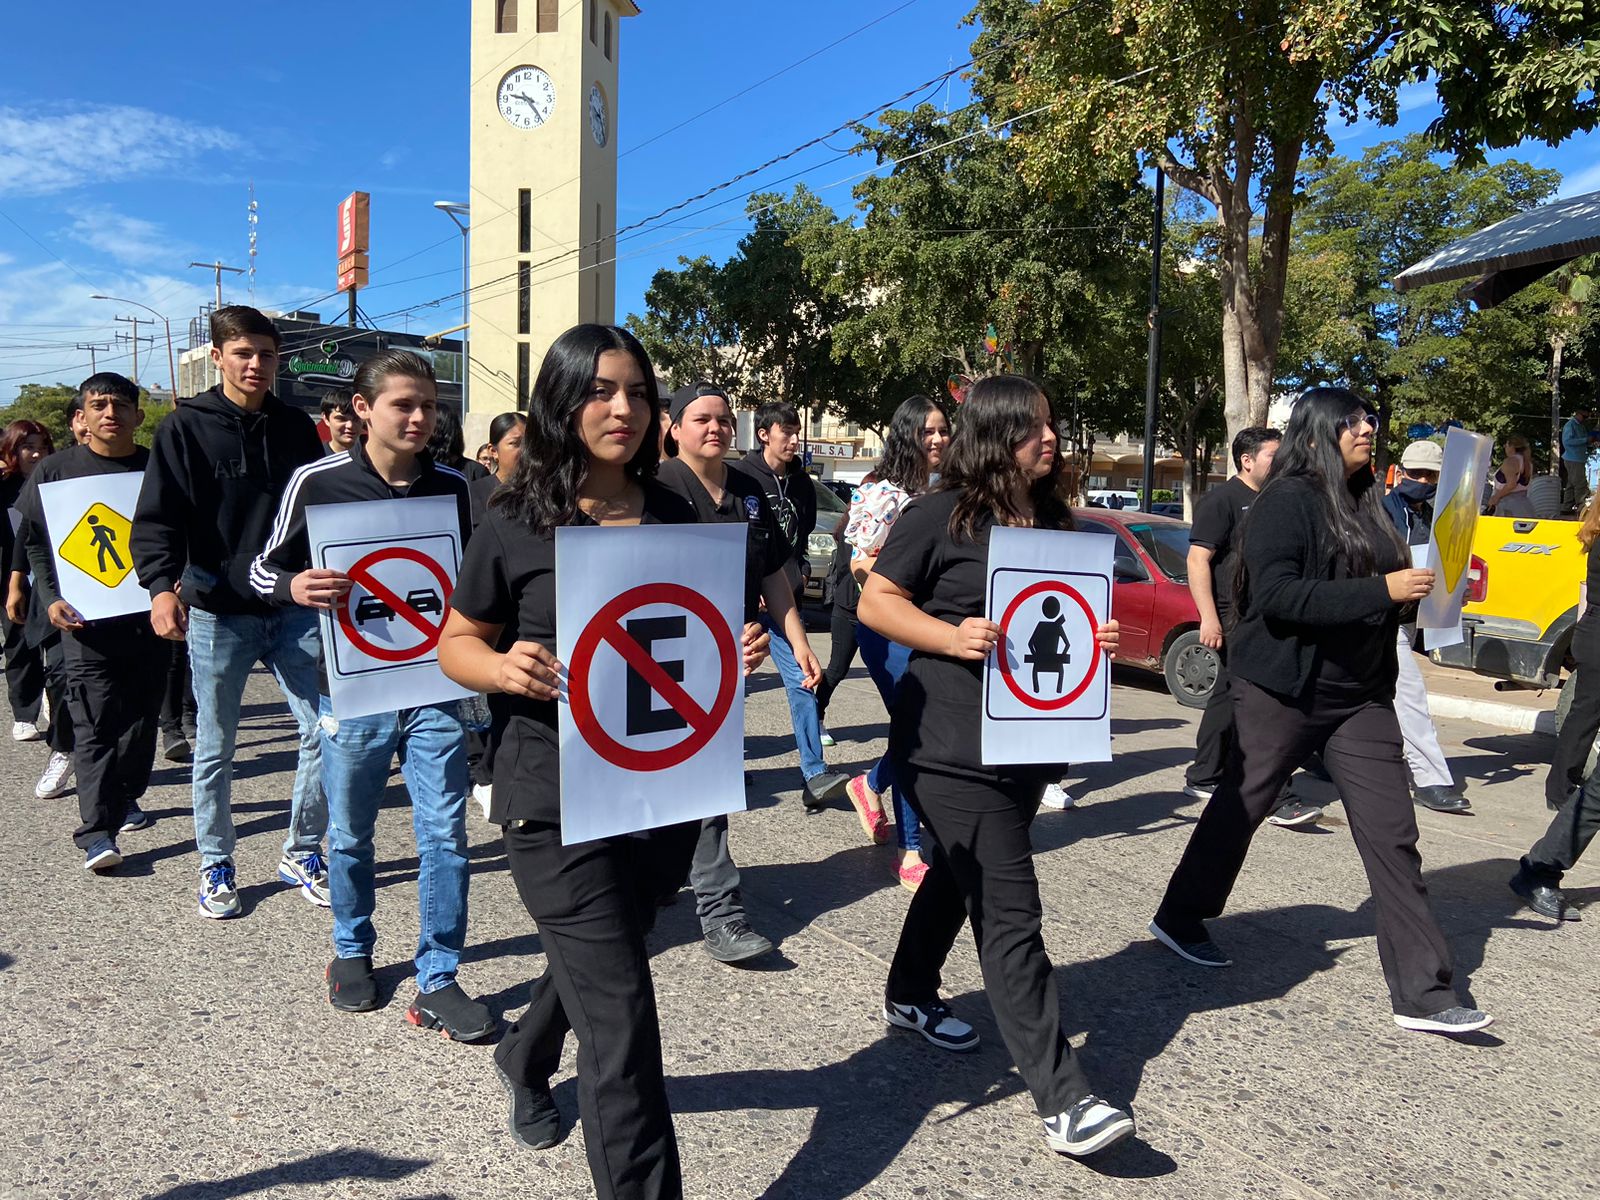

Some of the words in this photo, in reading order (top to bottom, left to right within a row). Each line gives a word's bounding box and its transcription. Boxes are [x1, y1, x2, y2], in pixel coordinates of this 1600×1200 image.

[515, 74, 521, 83] 11
[524, 71, 532, 80] 12
[506, 83, 514, 92] 10
[543, 82, 549, 91] 2
[502, 94, 509, 103] 9
[546, 94, 552, 103] 3
[506, 106, 512, 115] 8
[542, 106, 548, 114] 4
[515, 114, 521, 122] 7
[524, 117, 530, 126] 6
[534, 114, 541, 123] 5
[1498, 542, 1561, 556] STX
[626, 615, 688, 737] E
